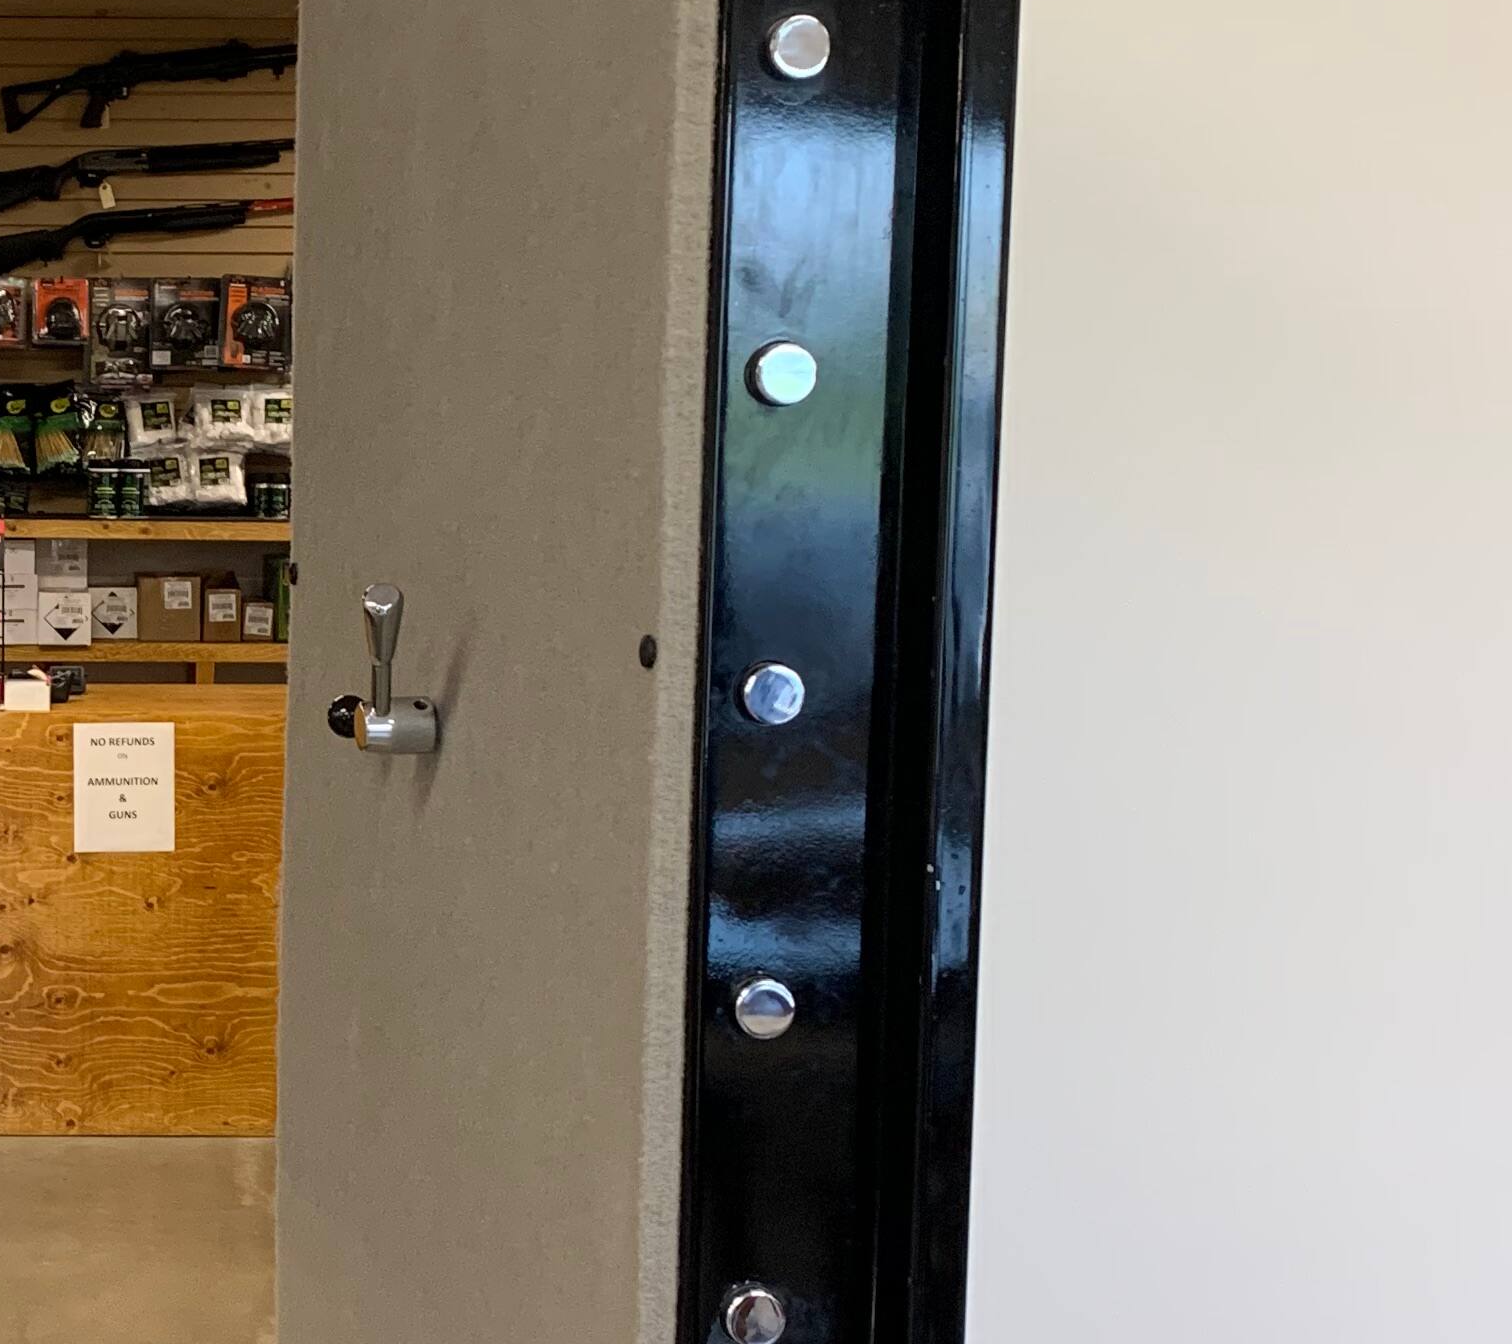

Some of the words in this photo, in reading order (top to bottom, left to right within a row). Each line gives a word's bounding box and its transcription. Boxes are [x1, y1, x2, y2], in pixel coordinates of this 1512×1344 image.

[90, 737, 106, 747] NO
[108, 737, 155, 747] REFUNDS
[87, 776, 159, 787] AMMUNITION
[118, 793, 127, 803] &
[108, 810, 138, 820] GUNS
